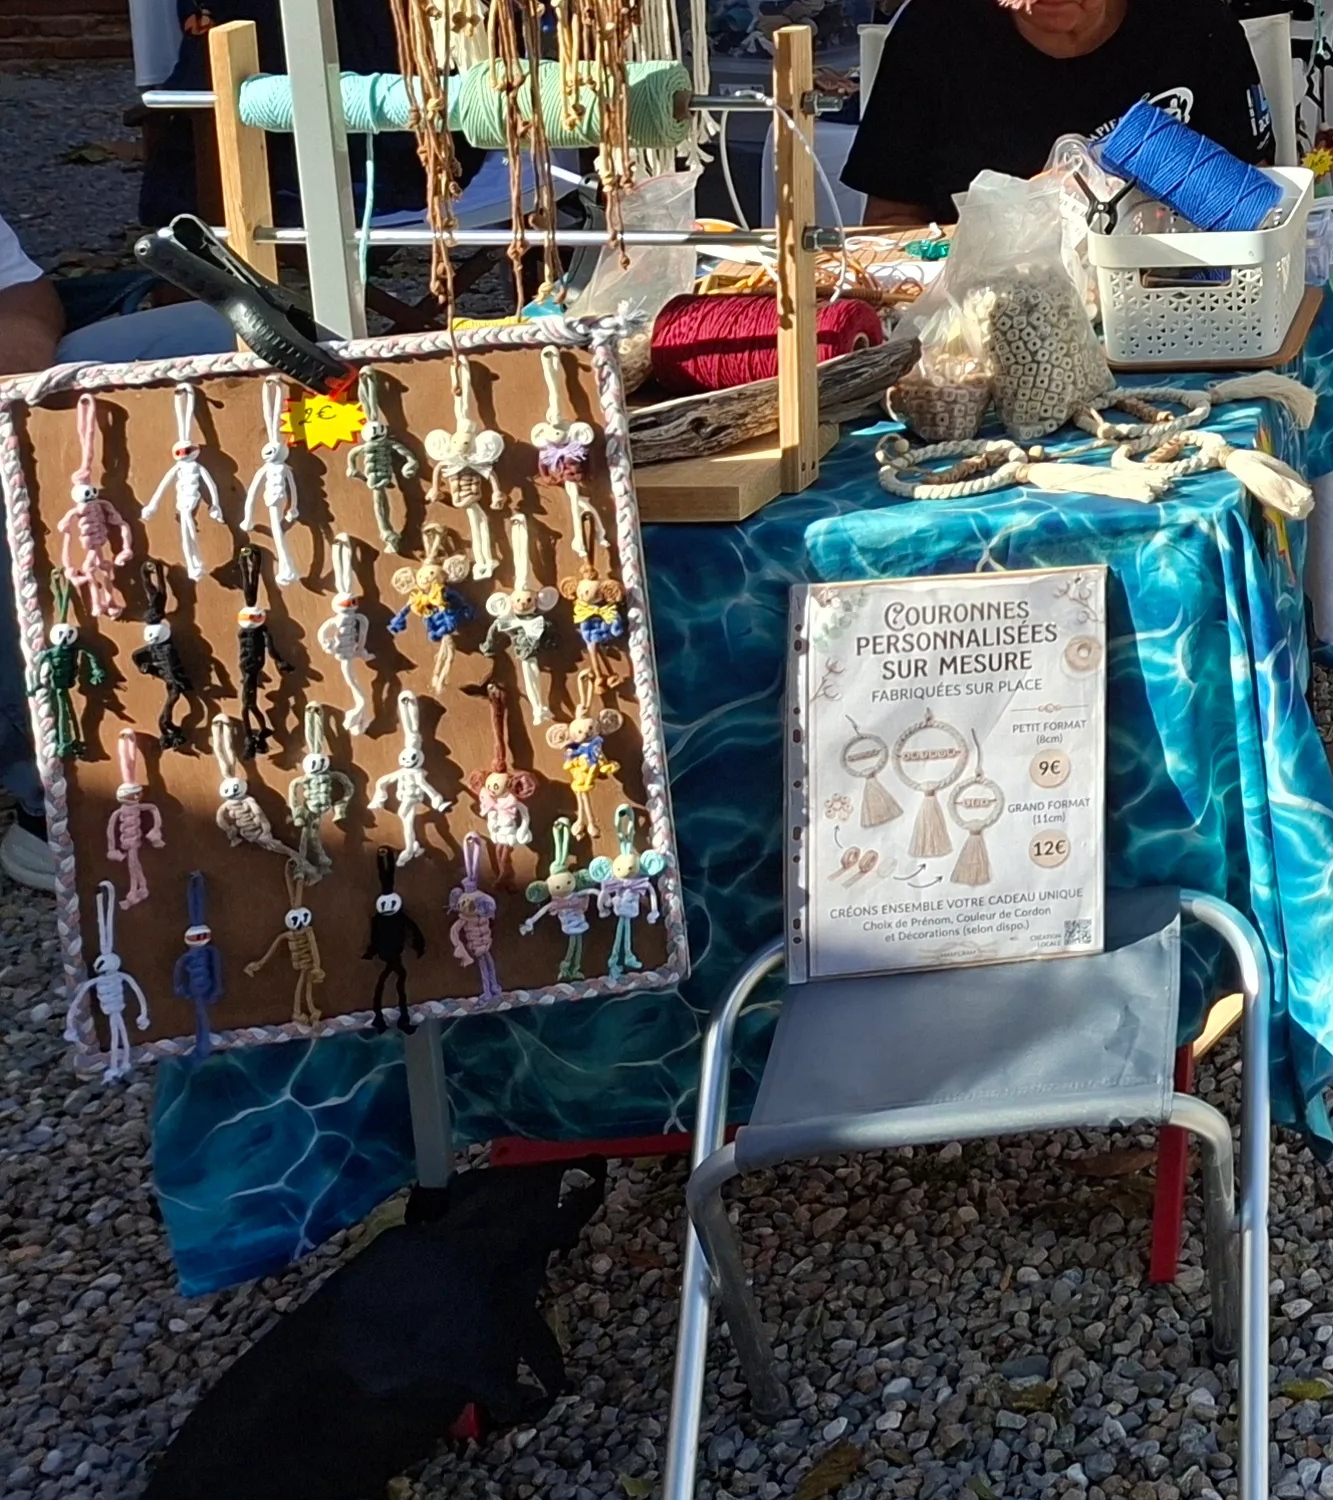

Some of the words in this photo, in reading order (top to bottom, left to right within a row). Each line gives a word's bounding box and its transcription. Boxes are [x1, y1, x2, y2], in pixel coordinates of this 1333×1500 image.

[856, 620, 1058, 656] PERSONNALISÉES
[882, 658, 928, 681] SUR
[939, 650, 1033, 677] MESURE
[871, 683, 961, 703] FABRIQUÉES
[965, 682, 994, 696] SUR
[998, 678, 1042, 693] PLACE
[1012, 722, 1041, 733] PETIT
[1043, 719, 1087, 731] FORMAT
[1036, 733, 1063, 746] (8cm)
[1038, 760, 1061, 776] 9€
[1007, 802, 1045, 813] GRAND
[1047, 798, 1091, 810] FORMAT
[1032, 813, 1066, 826] (11cm)
[1033, 840, 1066, 856] 12€
[830, 903, 878, 920] CRÉONS
[881, 900, 944, 915] ENSEMBLE
[947, 897, 985, 910] VOTRE
[988, 893, 1036, 906] CADEAU
[1038, 888, 1083, 902] UNIQUE
[862, 920, 893, 932] Choix
[895, 918, 908, 930] de
[910, 915, 954, 928] Prénom,
[956, 912, 997, 924] Couleur
[999, 909, 1012, 921] de
[1014, 906, 1051, 919] Cordon
[885, 932, 896, 943] et
[898, 924, 960, 942] Décorations
[962, 921, 994, 936] (selon
[996, 919, 1030, 934] dispo.)
